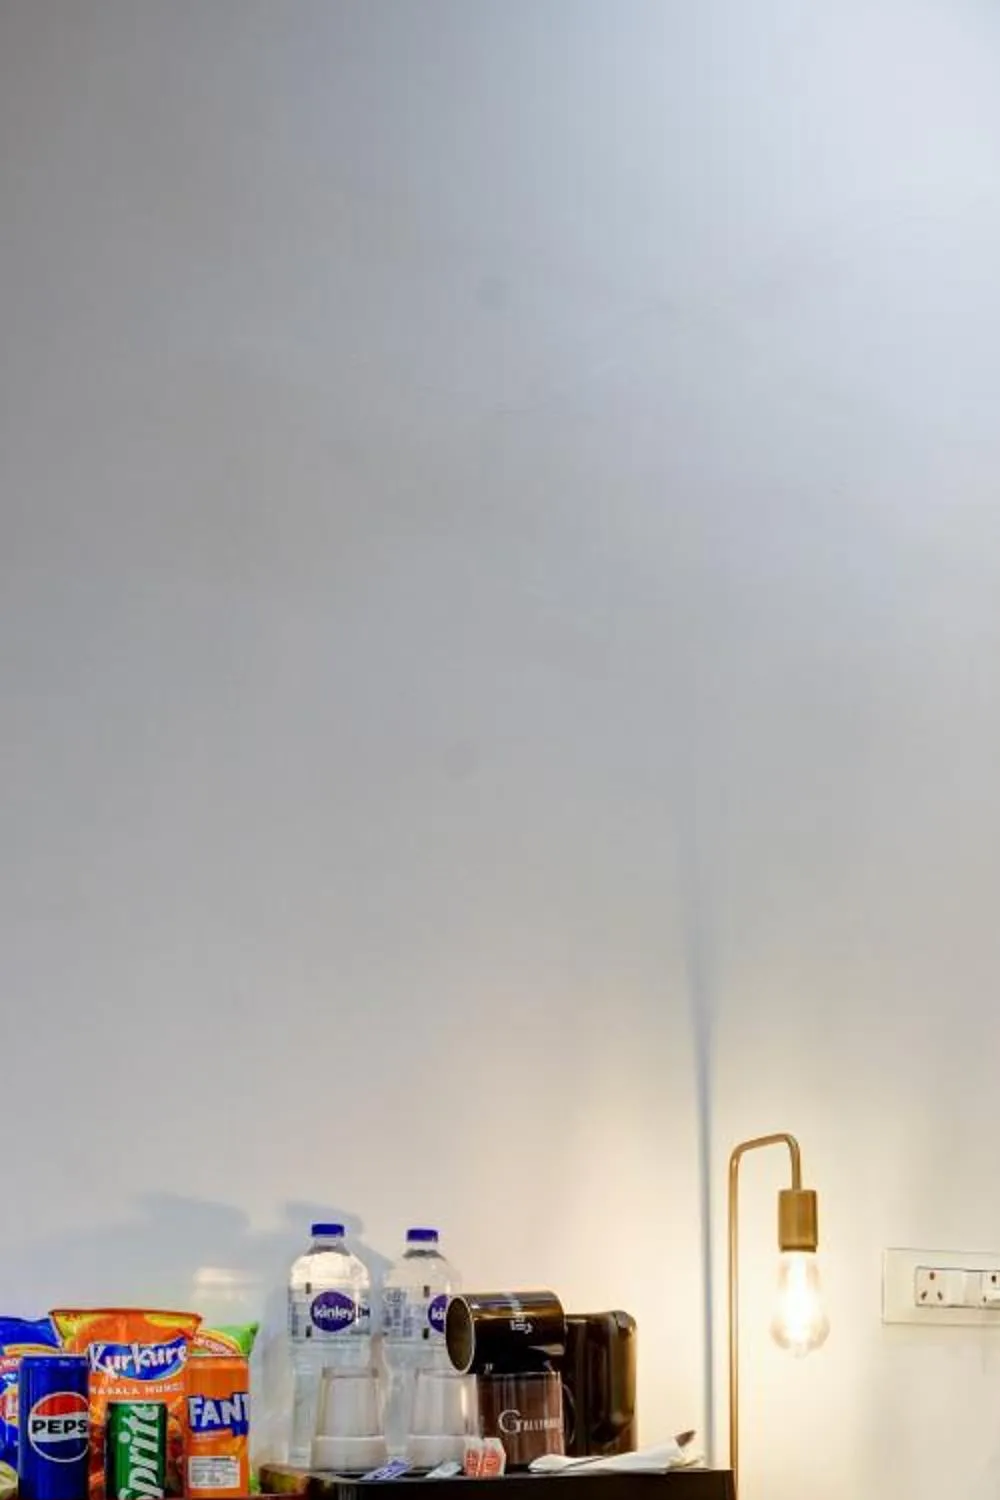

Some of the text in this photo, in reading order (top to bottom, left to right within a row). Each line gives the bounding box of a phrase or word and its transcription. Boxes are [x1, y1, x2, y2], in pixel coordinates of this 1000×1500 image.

[314, 1304, 352, 1321] kinley
[188, 1394, 249, 1428] FANT
[32, 1419, 88, 1434] PEPS
